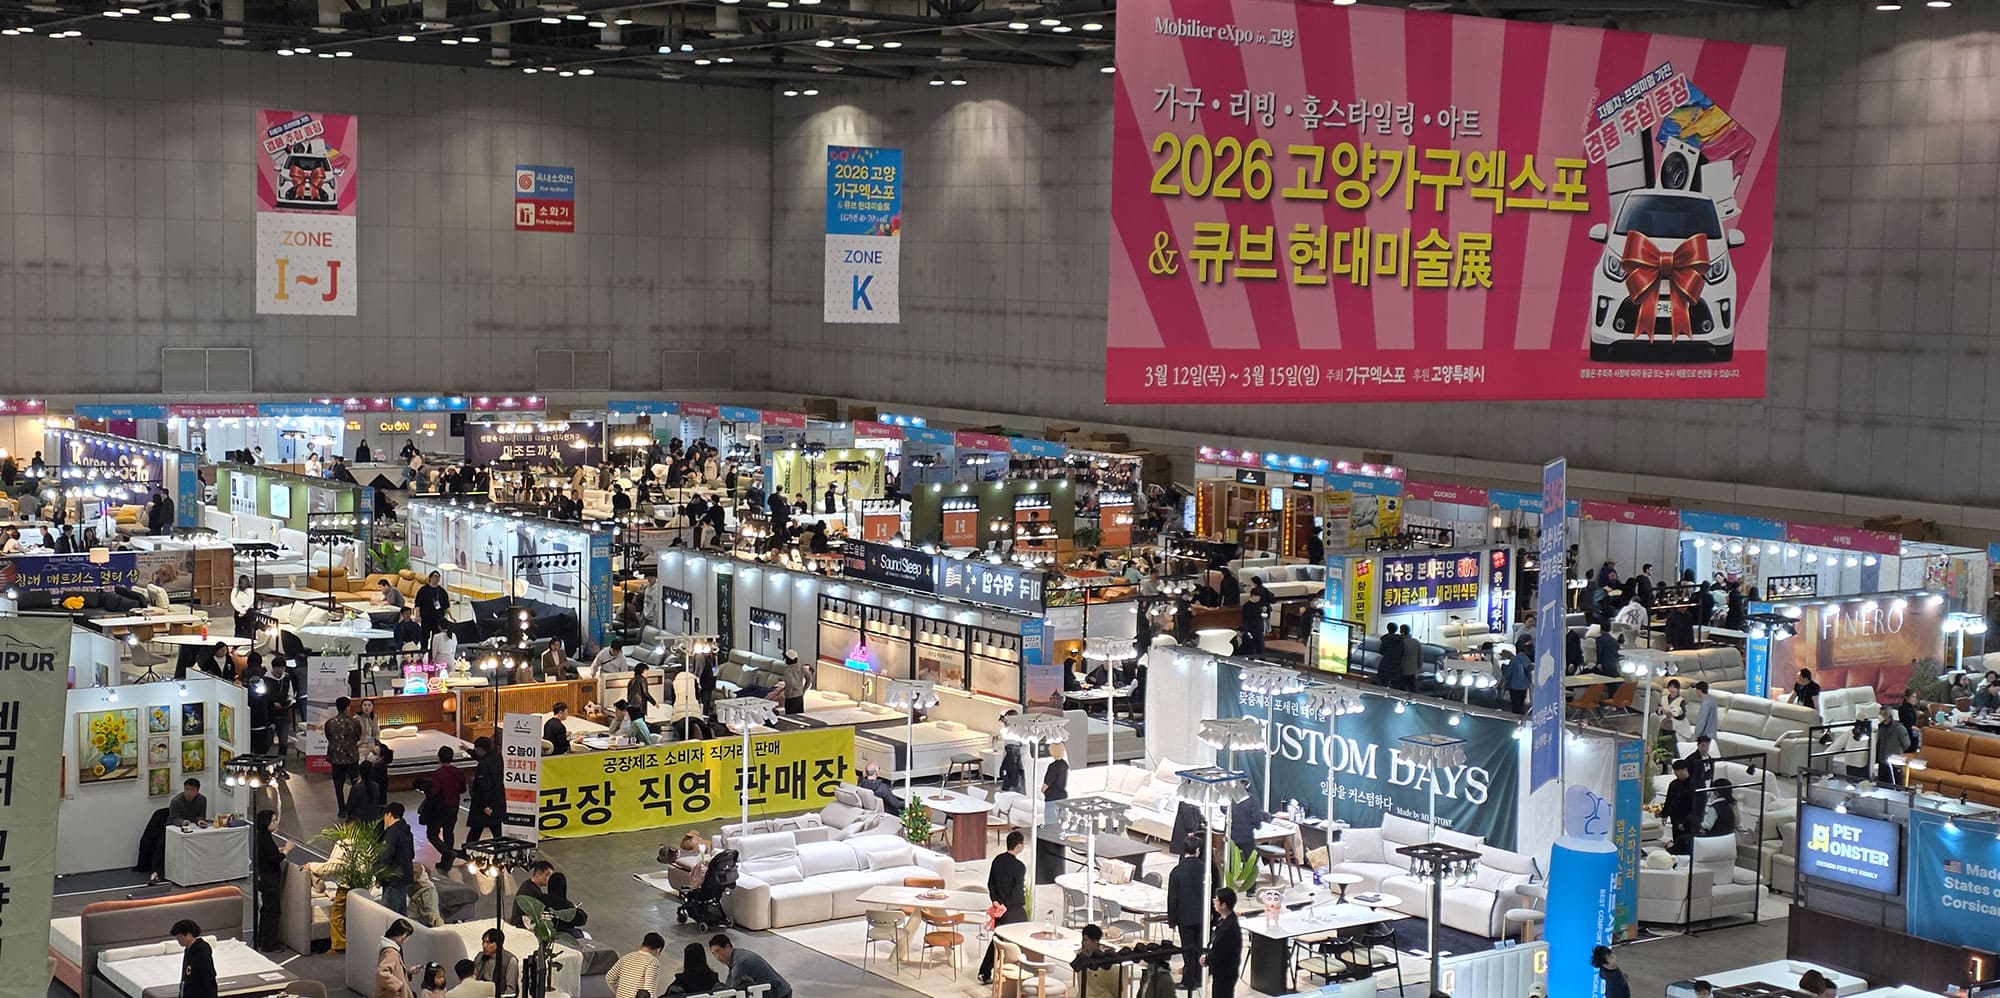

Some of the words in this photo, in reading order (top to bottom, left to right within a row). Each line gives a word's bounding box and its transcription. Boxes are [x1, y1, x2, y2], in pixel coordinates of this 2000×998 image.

[1155, 16, 1216, 39] Mobilier
[1218, 24, 1253, 46] eXpo
[1256, 31, 1266, 44] in
[1269, 28, 1295, 47] 고양
[1154, 84, 1205, 122] 가구
[1230, 89, 1276, 128] 리빙
[1299, 95, 1415, 137] 홈스타일링
[1436, 104, 1482, 139] 아트
[1585, 120, 1622, 161] 경품
[1620, 96, 1656, 137] 추첨
[1655, 75, 1689, 116] 증정
[536, 172, 574, 185] 옥내소화전
[834, 165, 869, 180] 2026
[871, 166, 896, 182] 고양
[1150, 132, 1274, 202] 2026
[1281, 141, 1590, 214] 고양가구엑스포
[834, 183, 895, 200] 가구엑스포
[539, 206, 569, 218] 소화기
[282, 230, 333, 248] ZONE
[844, 250, 883, 264] ZONE
[1148, 231, 1179, 276] &
[1188, 221, 1278, 284] 큐브
[1288, 223, 1494, 289] 현대미술展
[852, 275, 874, 311] K
[1144, 364, 1168, 387] 3월
[1173, 364, 1226, 387] 12일(목)
[1242, 364, 1265, 387] 3월
[1269, 364, 1321, 387] 15일(일)
[1326, 368, 1344, 383] 주최
[1345, 365, 1406, 385] 가구엑스포
[1412, 368, 1430, 383] 후원
[1431, 365, 1486, 385] 고양특례시
[1434, 490, 1457, 499] CUCKOO
[15, 574, 41, 587] 침대
[46, 572, 94, 586] 매트리스
[100, 570, 123, 585] 멀티
[126, 568, 140, 583] 샵
[1385, 562, 1414, 583] 규수방
[1457, 557, 1478, 578] 50%
[1384, 587, 1427, 607] 통가죽소파
[1436, 583, 1478, 603] 세라믹식탁
[1822, 607, 1904, 641] FINERO
[1754, 654, 1762, 698] FINE
[1273, 697, 1299, 716] 포세린
[507, 745, 536, 758] 오늘이
[603, 756, 659, 773] 공장제조
[663, 747, 705, 767] 소비자
[755, 740, 780, 757] 판매
[506, 759, 536, 771] 최저가
[505, 772, 537, 784] SALE
[1388, 747, 1490, 805] DAYS
[539, 780, 616, 830] 공장
[638, 768, 711, 817] 직영
[734, 755, 848, 805] 판매장
[1348, 790, 1393, 810] 커스텀하다
[1397, 806, 1412, 818] Made
[1832, 822, 1863, 843] PET
[1943, 876, 1990, 896] States
